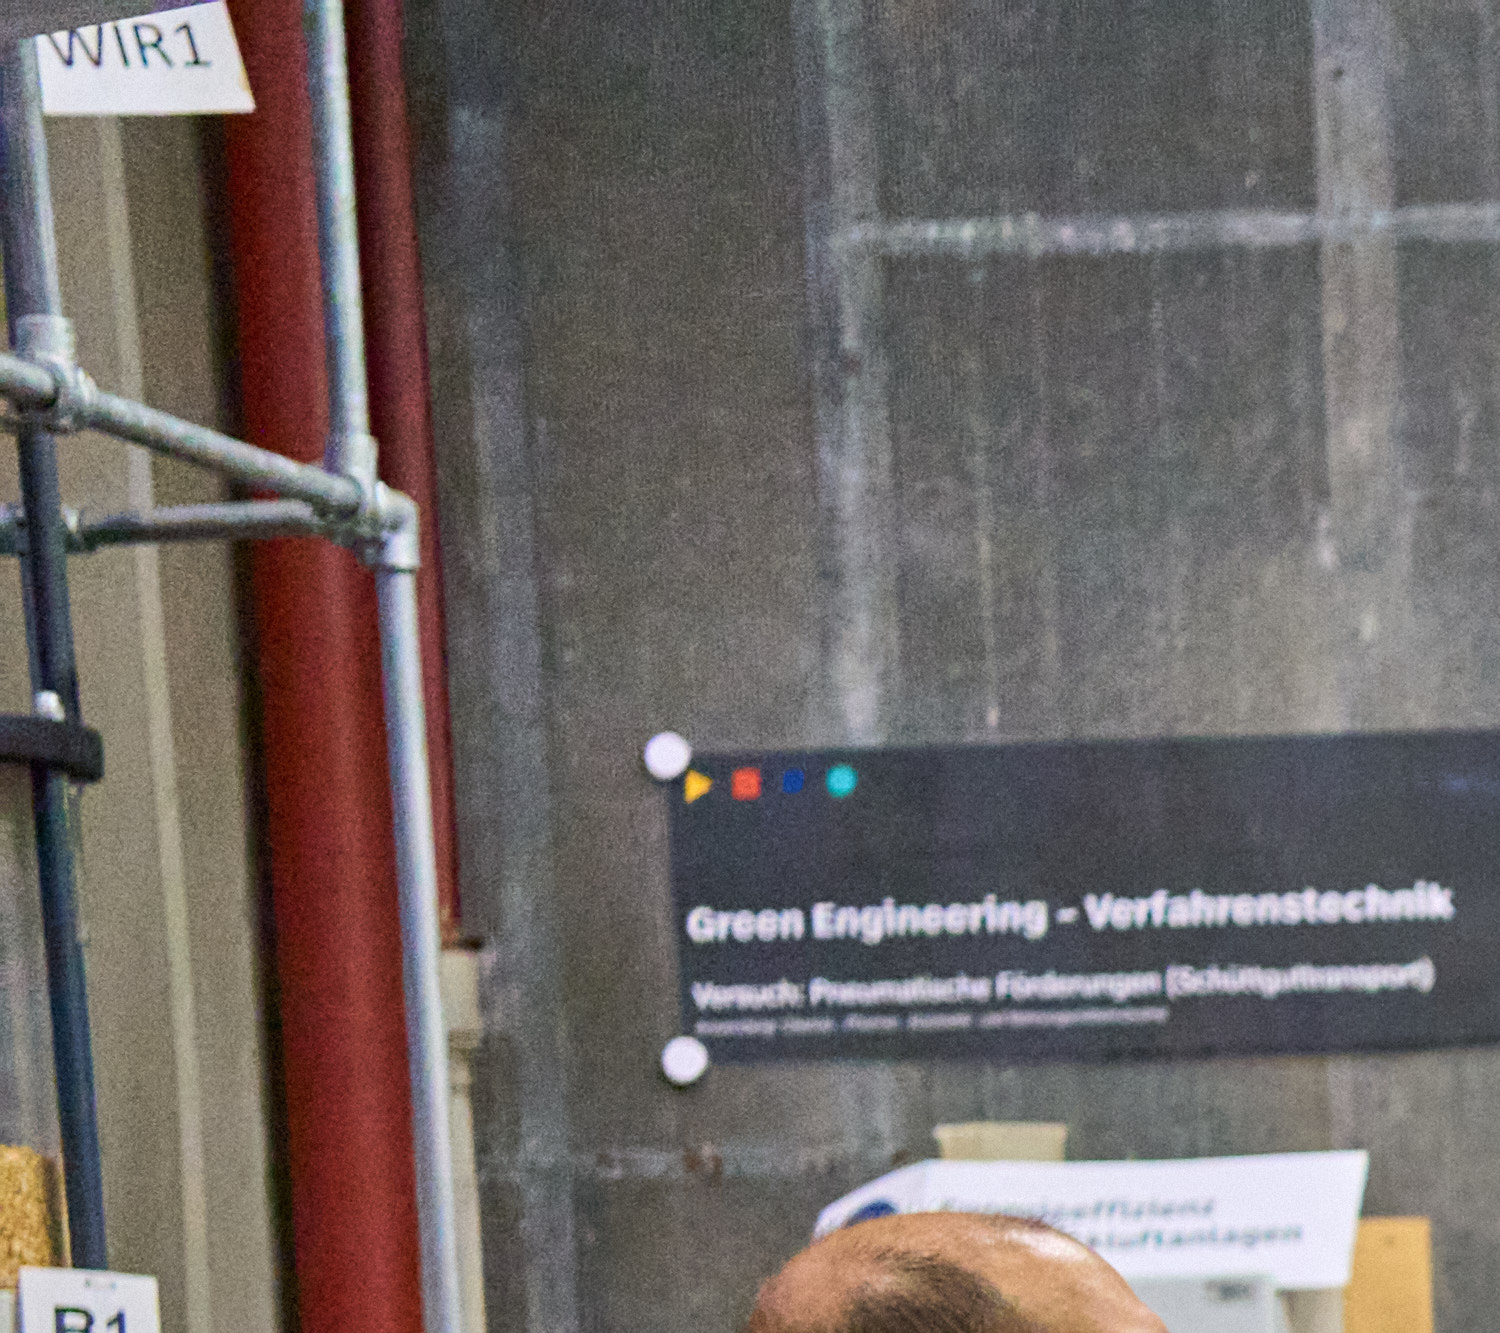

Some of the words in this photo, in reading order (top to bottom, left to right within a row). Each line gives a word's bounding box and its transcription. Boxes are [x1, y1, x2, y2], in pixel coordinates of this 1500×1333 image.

[50, 22, 212, 68] WIR1
[687, 905, 805, 944] Green
[811, 893, 1049, 946] Engineering
[1084, 880, 1456, 931] Verfahrenstechnik
